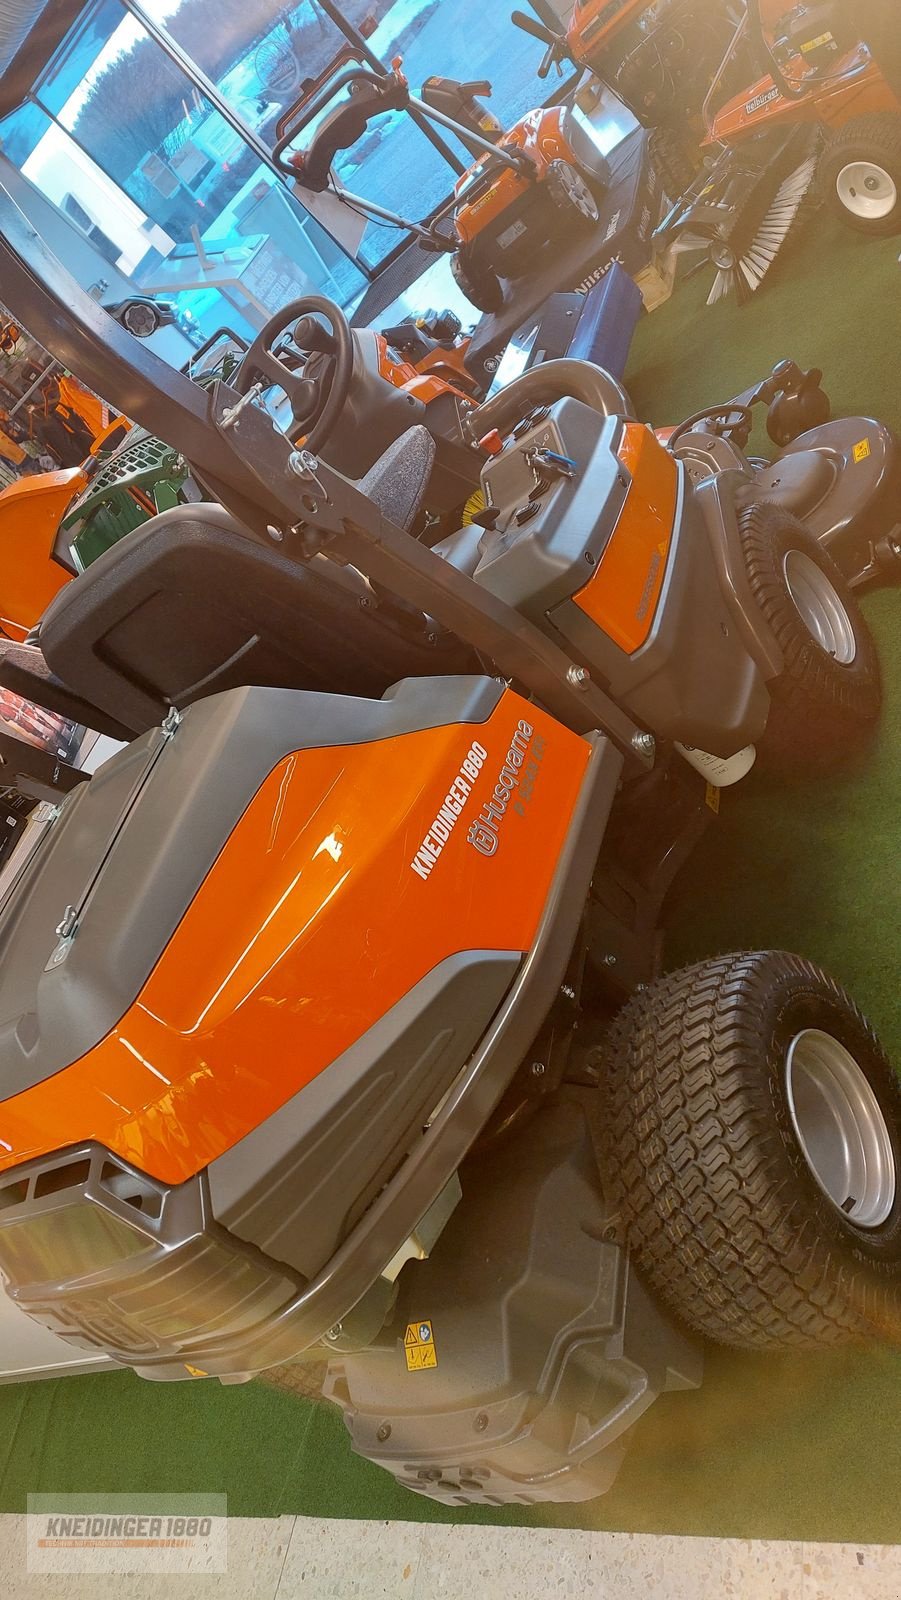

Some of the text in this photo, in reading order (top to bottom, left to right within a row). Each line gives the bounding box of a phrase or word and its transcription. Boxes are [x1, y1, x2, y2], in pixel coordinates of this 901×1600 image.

[410, 740, 488, 881] KNEIDINGER 1880
[479, 719, 534, 832] Husqvarna
